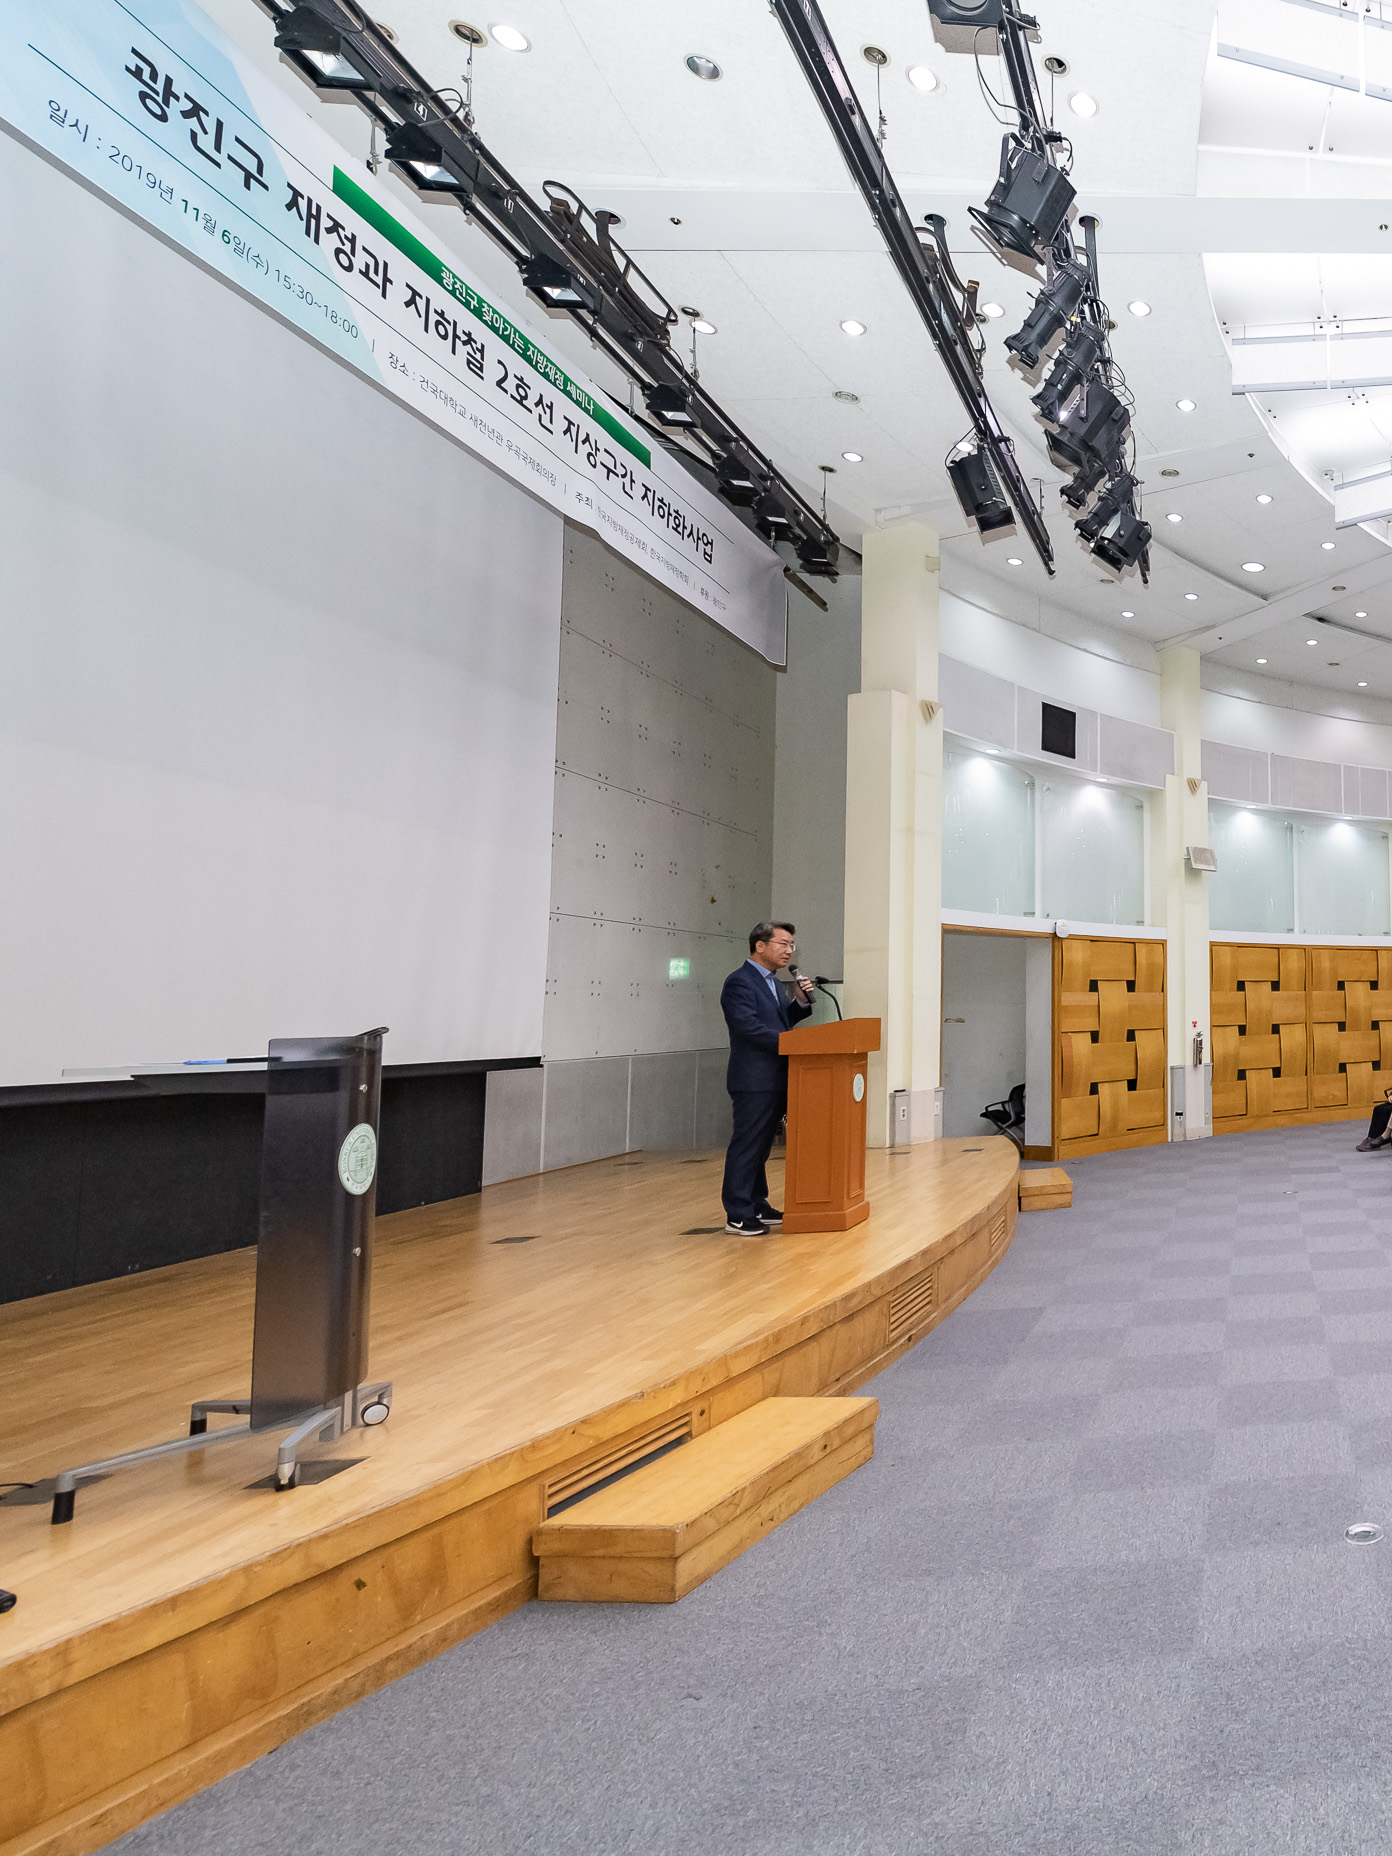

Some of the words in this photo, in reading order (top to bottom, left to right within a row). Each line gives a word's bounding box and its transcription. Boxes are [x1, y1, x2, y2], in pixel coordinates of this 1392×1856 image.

[47, 99, 89, 144] 일시
[108, 145, 174, 205] 2019년
[181, 198, 219, 236] 11월
[221, 229, 270, 276] 6일(수)
[274, 269, 359, 341] 15:30~18:00
[388, 351, 410, 377] 장소
[419, 374, 467, 419] 건국대학교
[469, 412, 504, 447] 새천년관
[505, 439, 557, 487] 우곡국제회의장
[574, 491, 593, 510] 주최
[124, 46, 269, 192] 광진구
[284, 181, 393, 300] 재정과
[403, 280, 486, 380] 지하철
[495, 358, 554, 435] 2호선
[563, 416, 635, 500] 지상구간
[640, 482, 714, 564] 지하화사업
[441, 266, 479, 310] 광진구
[481, 302, 524, 353] 찾아가는
[527, 344, 564, 389] 지방재정
[566, 382, 595, 415] 세미나
